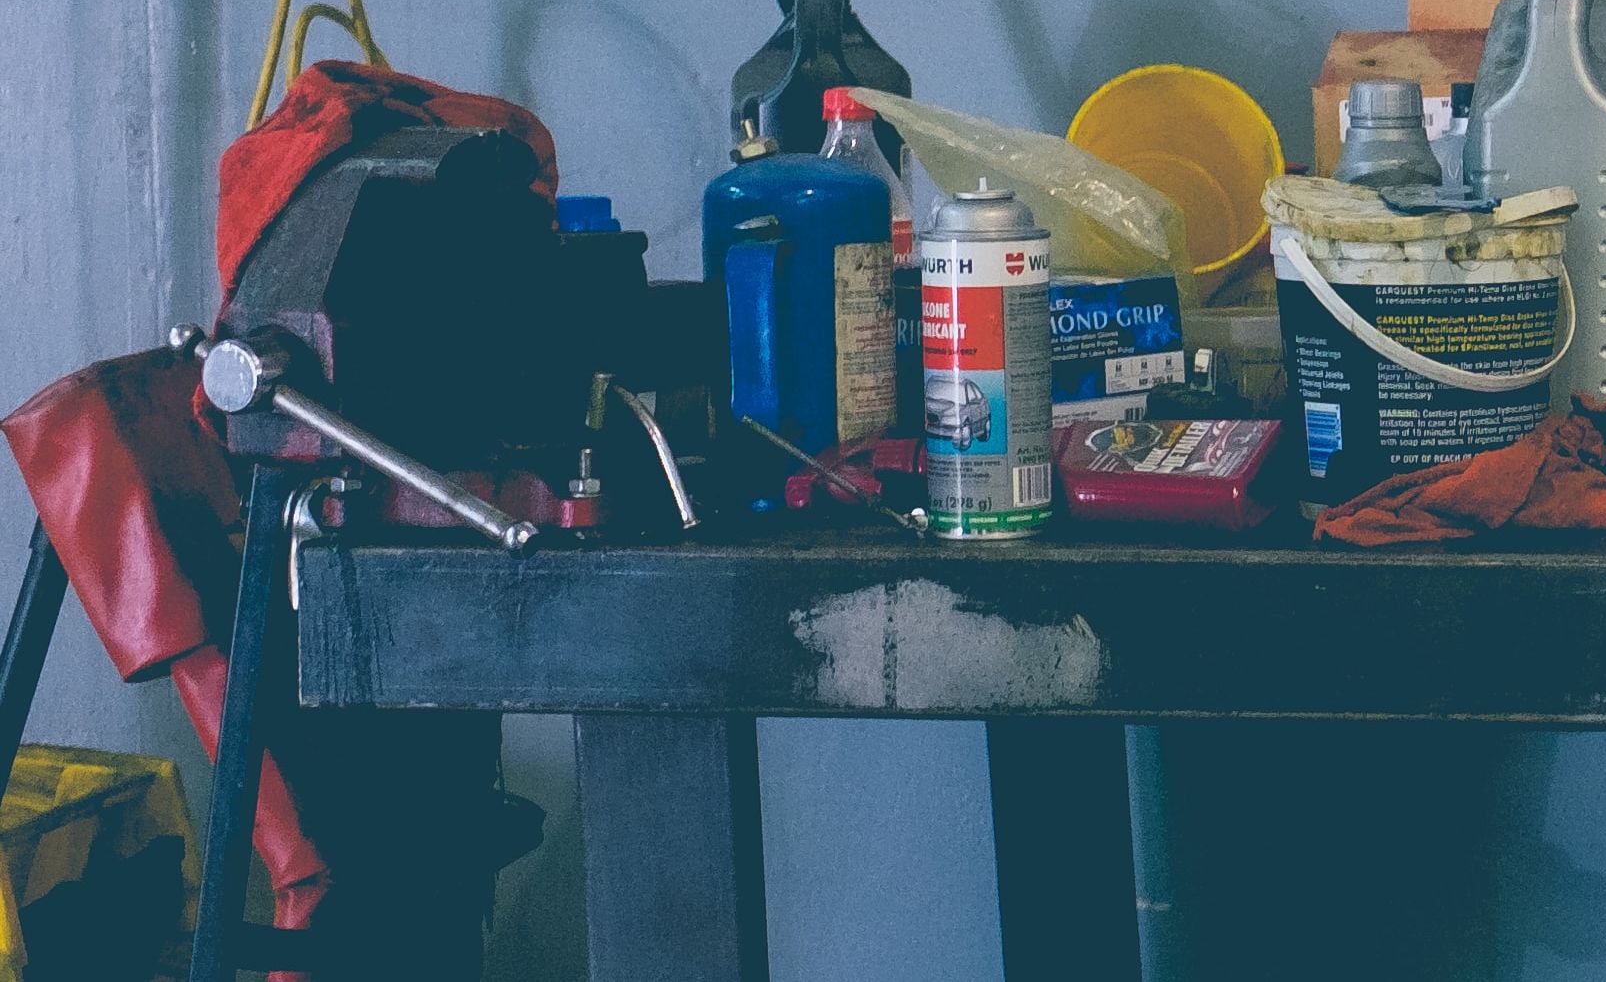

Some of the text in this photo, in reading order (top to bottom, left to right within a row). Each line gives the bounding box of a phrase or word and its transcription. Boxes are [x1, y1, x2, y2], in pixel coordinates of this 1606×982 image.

[1375, 286, 1425, 296] CARQUEST
[1116, 303, 1164, 328] GRIP
[1375, 315, 1425, 325] CARQUEST
[1399, 438, 1419, 447] soap
[1420, 438, 1436, 446] and
[1403, 455, 1419, 464] OUT
[1421, 455, 1432, 464] OF
[1434, 454, 1461, 463] REACH
